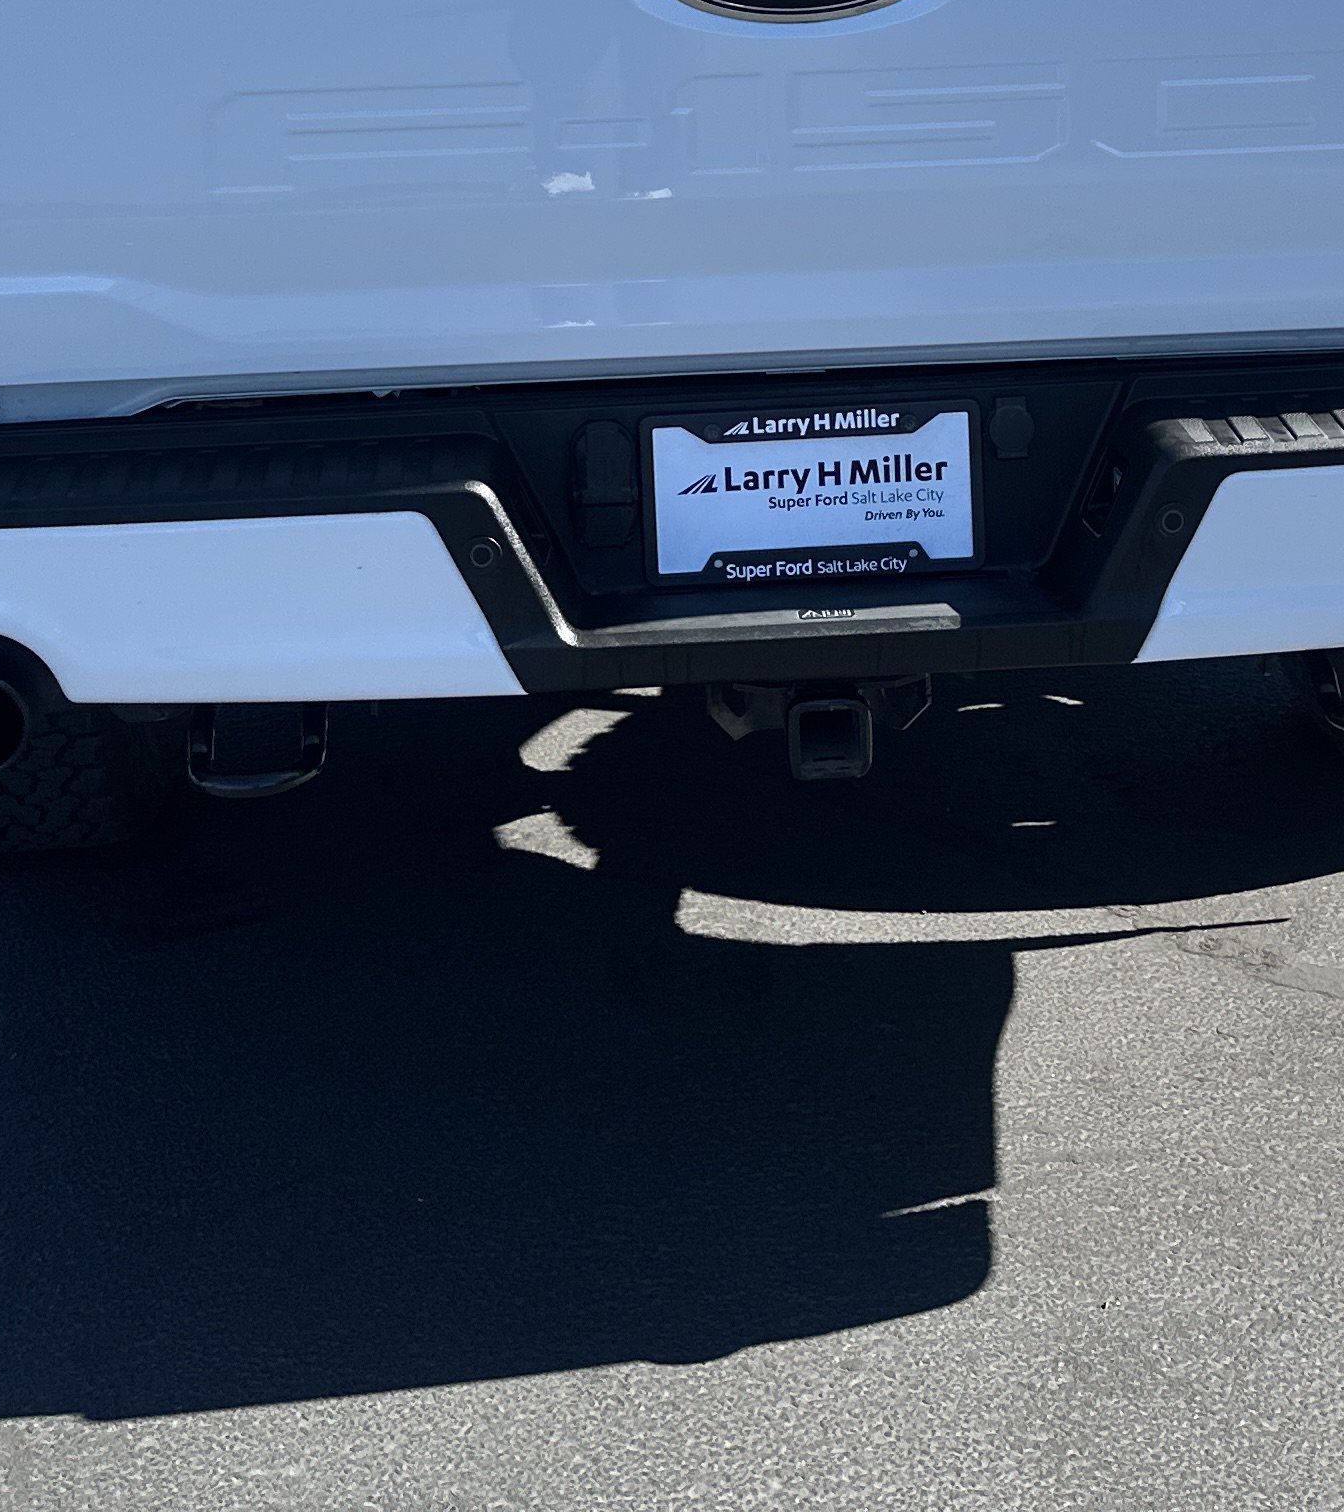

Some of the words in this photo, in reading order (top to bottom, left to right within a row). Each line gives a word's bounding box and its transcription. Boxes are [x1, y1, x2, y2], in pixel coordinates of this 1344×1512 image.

[752, 416, 810, 436] Larry
[813, 413, 831, 431] H
[834, 408, 900, 430] Miller
[724, 466, 811, 494] Larry
[817, 461, 842, 487] H
[849, 453, 948, 485] Miller
[768, 496, 811, 511] Super
[815, 491, 848, 506] Ford
[851, 491, 876, 505] Salt
[880, 489, 913, 504] Lake
[916, 488, 944, 504] City
[864, 510, 903, 521] Driven
[905, 509, 920, 521] By
[726, 563, 773, 581] Super
[776, 559, 813, 576] Ford
[817, 559, 843, 574] Salt
[846, 557, 878, 572] Lake
[880, 556, 907, 573] City
